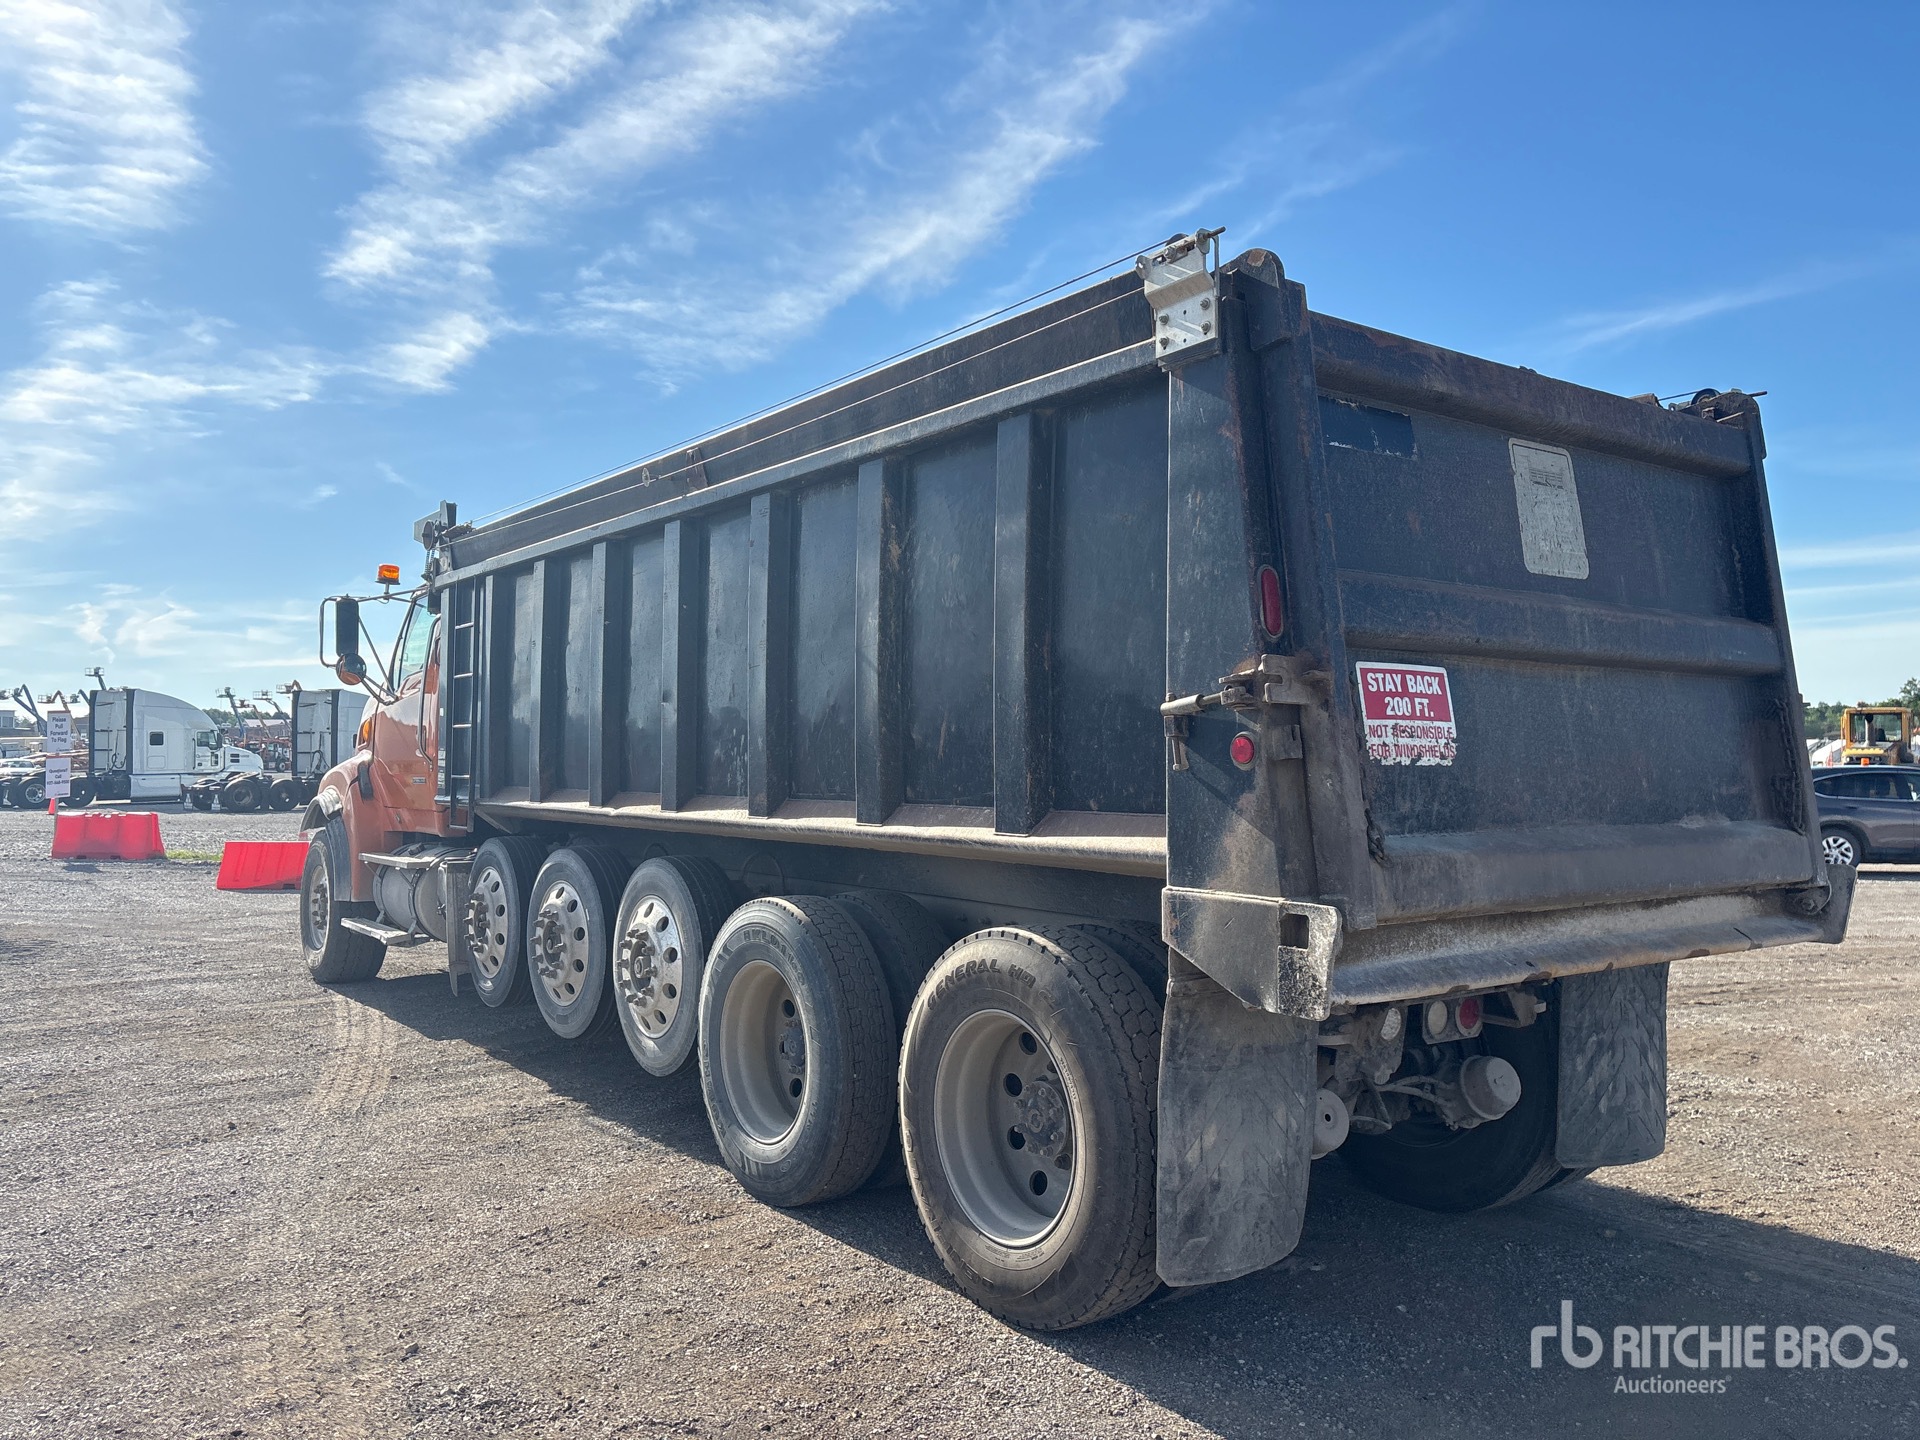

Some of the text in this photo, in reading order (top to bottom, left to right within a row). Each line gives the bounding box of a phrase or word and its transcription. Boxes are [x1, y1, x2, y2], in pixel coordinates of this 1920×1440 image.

[1367, 673, 1442, 695] STAY BACK
[1384, 696, 1434, 718] 200 FT.
[57, 736, 67, 744] Flag
[1368, 724, 1453, 739] NOT RESPONSIBLE
[1370, 743, 1456, 759] FOR WINDSHIELDS
[927, 958, 1001, 1010] GENERAL
[1007, 963, 1037, 989] HD
